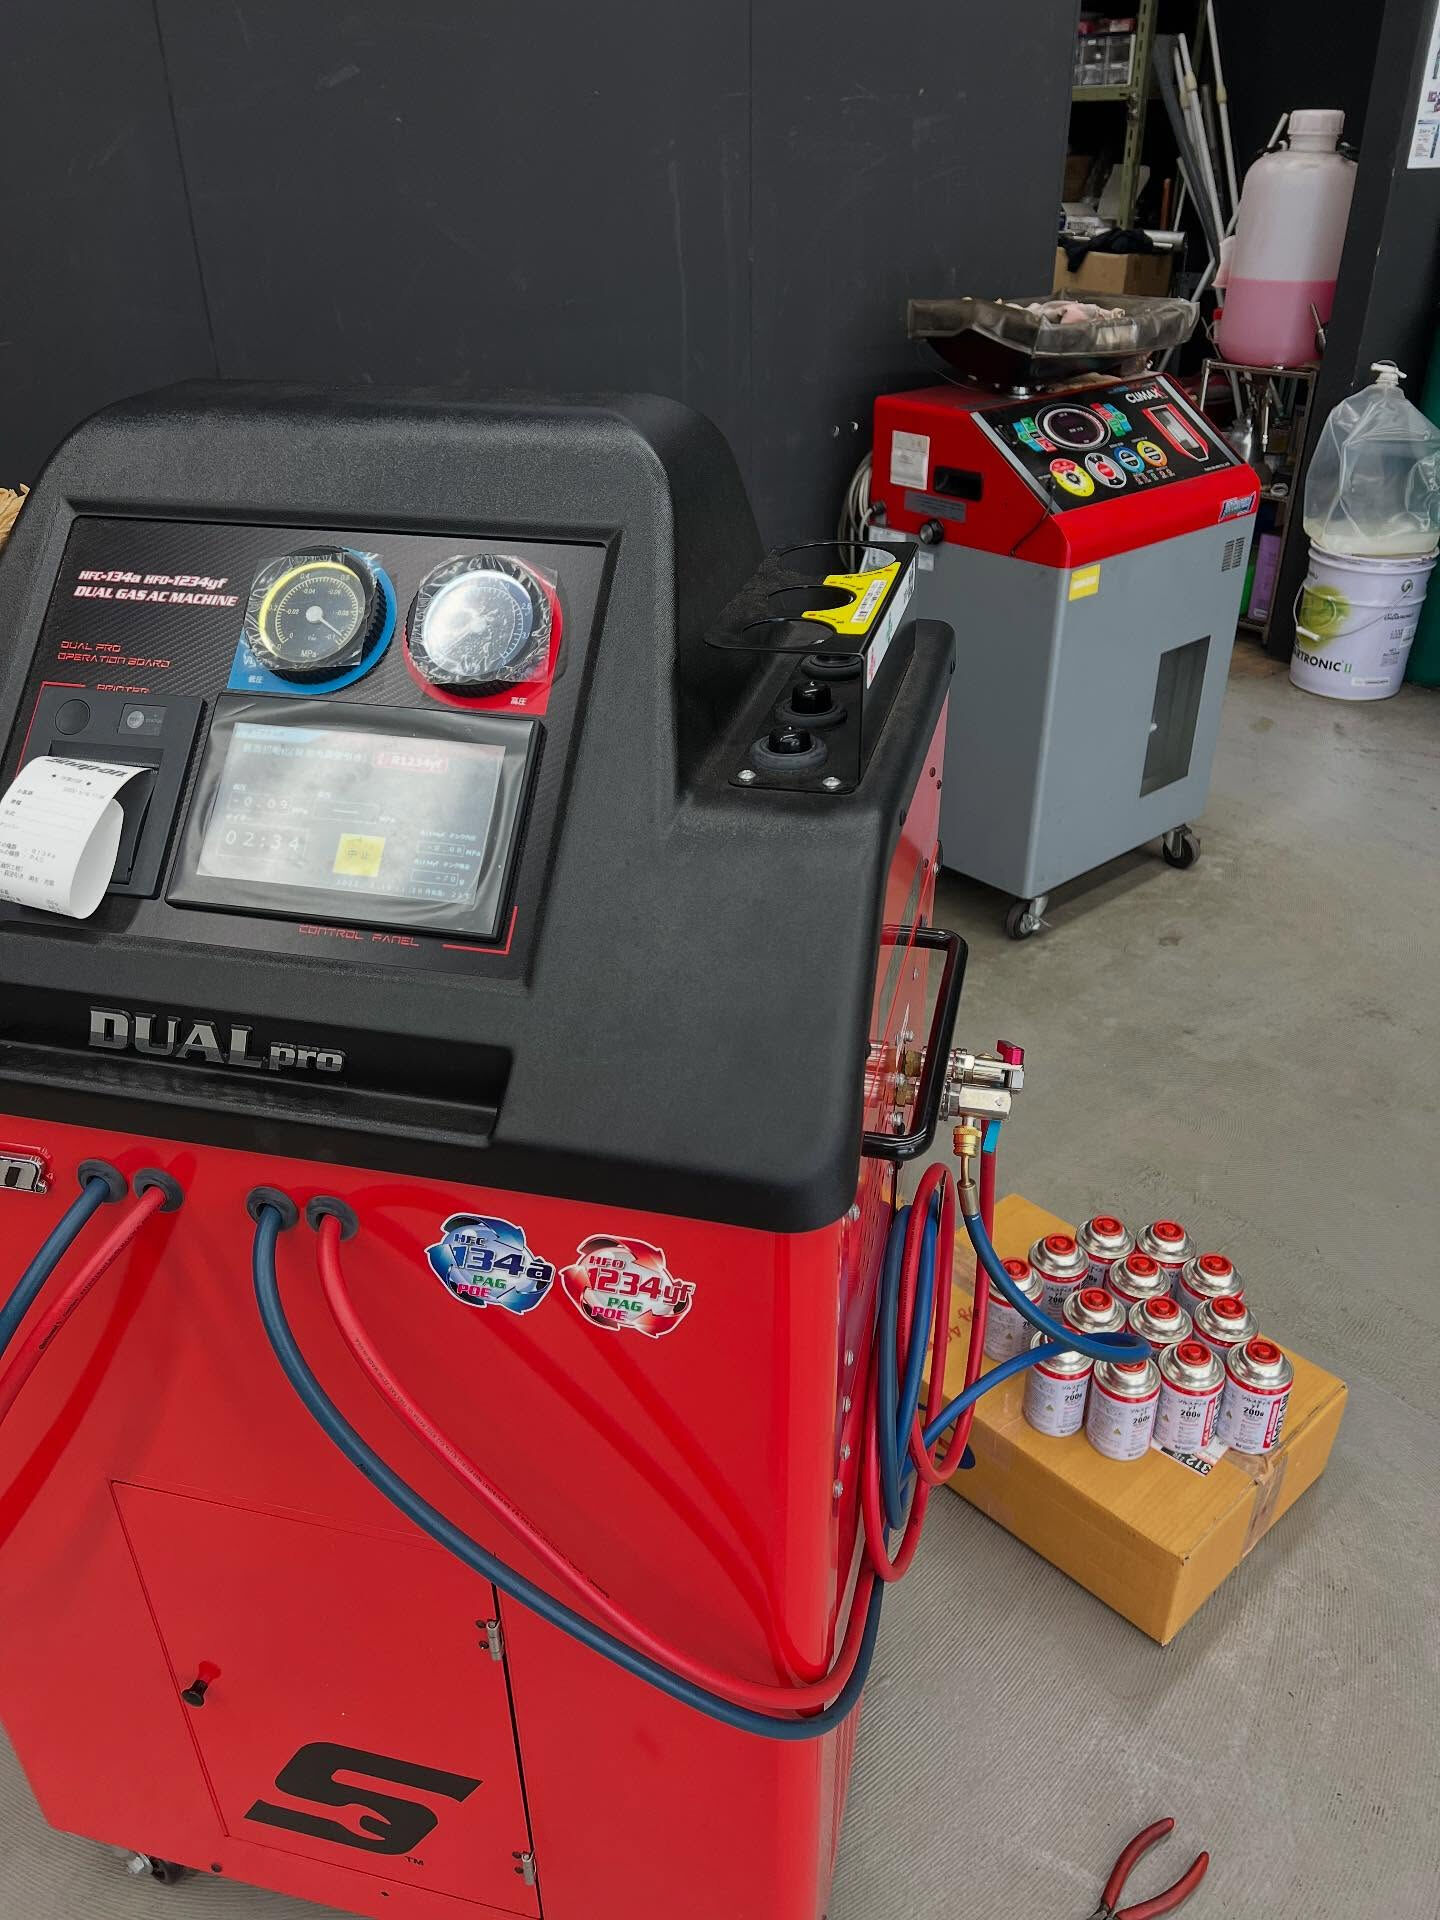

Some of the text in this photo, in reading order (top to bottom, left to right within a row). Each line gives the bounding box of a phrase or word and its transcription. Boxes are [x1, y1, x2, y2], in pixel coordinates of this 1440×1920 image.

[78, 570, 229, 590] HFC-134a HFO-1234yf
[73, 585, 239, 607] DUAL GAS AC MACHINE
[60, 640, 122, 653] DUAL PRO
[57, 652, 171, 668] OPERATION BOARD
[96, 684, 150, 694] PRINTER
[510, 697, 528, 706] 高圧
[225, 830, 299, 851] 02:34
[298, 924, 419, 948] CONTROL PANEL
[88, 1006, 348, 1074] DUAL pro
[454, 1233, 486, 1247] HFC
[450, 1245, 555, 1283] 134a
[588, 1255, 625, 1269] HFO
[472, 1274, 507, 1289] PAG
[587, 1267, 696, 1305] 1234yf
[457, 1284, 490, 1298] POE
[607, 1297, 643, 1312] PAG
[591, 1306, 628, 1321] POE
